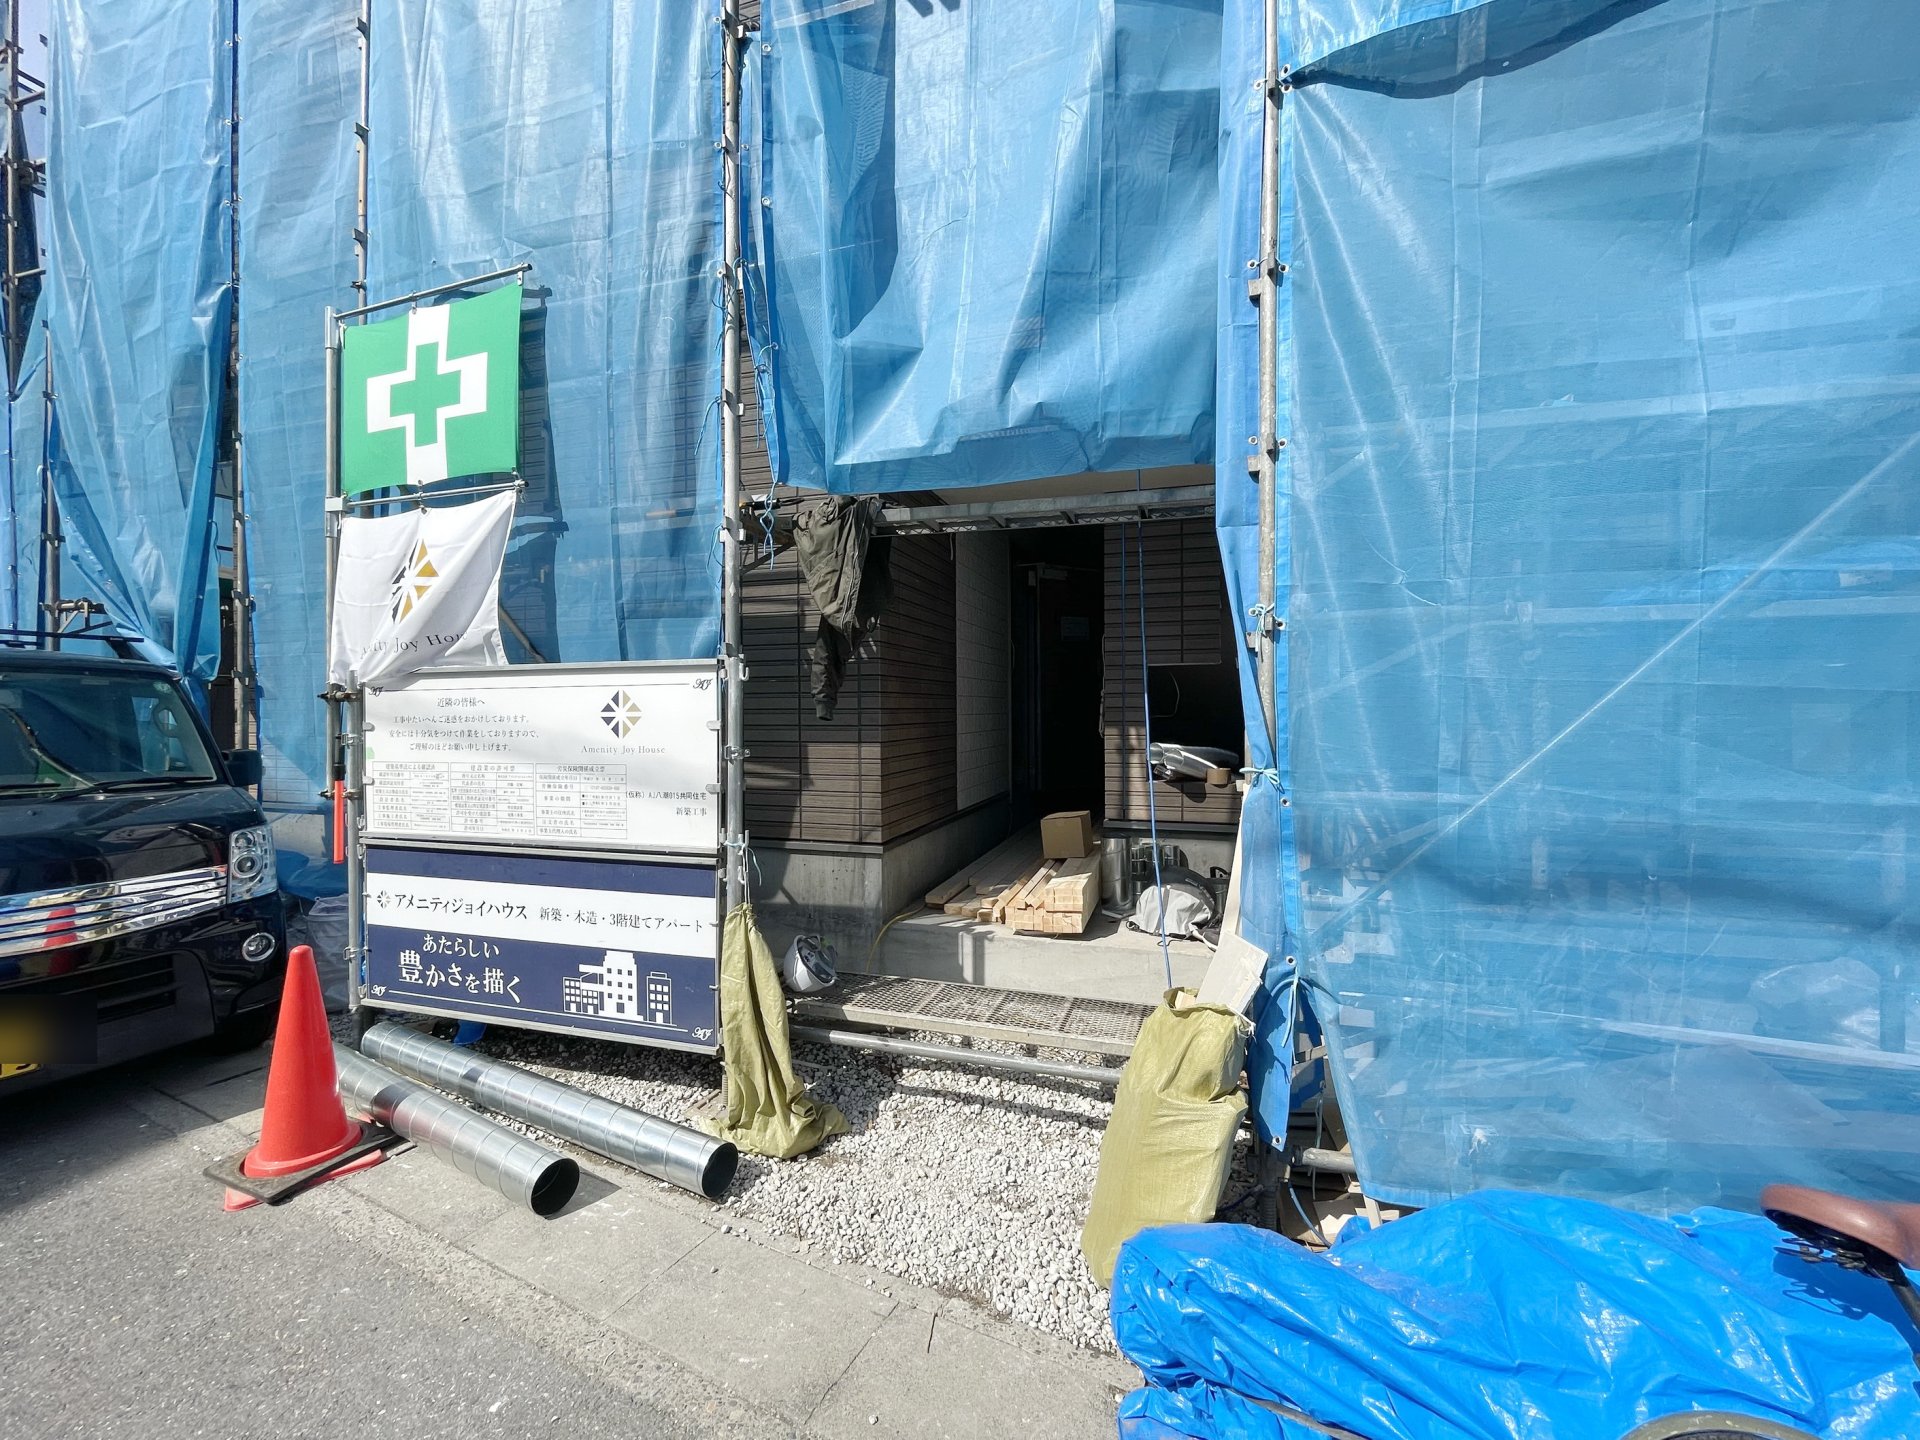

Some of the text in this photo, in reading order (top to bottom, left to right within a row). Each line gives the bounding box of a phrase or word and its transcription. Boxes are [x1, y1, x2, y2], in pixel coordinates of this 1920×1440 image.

[394, 637, 418, 653] Joy
[437, 697, 486, 709] 近隣の皆様へ
[581, 745, 665, 756] Amenity Joy House
[394, 893, 528, 920] アメニティジョイハウス
[422, 933, 500, 959] あたらしい
[398, 949, 522, 1004] 豊かさを描く
